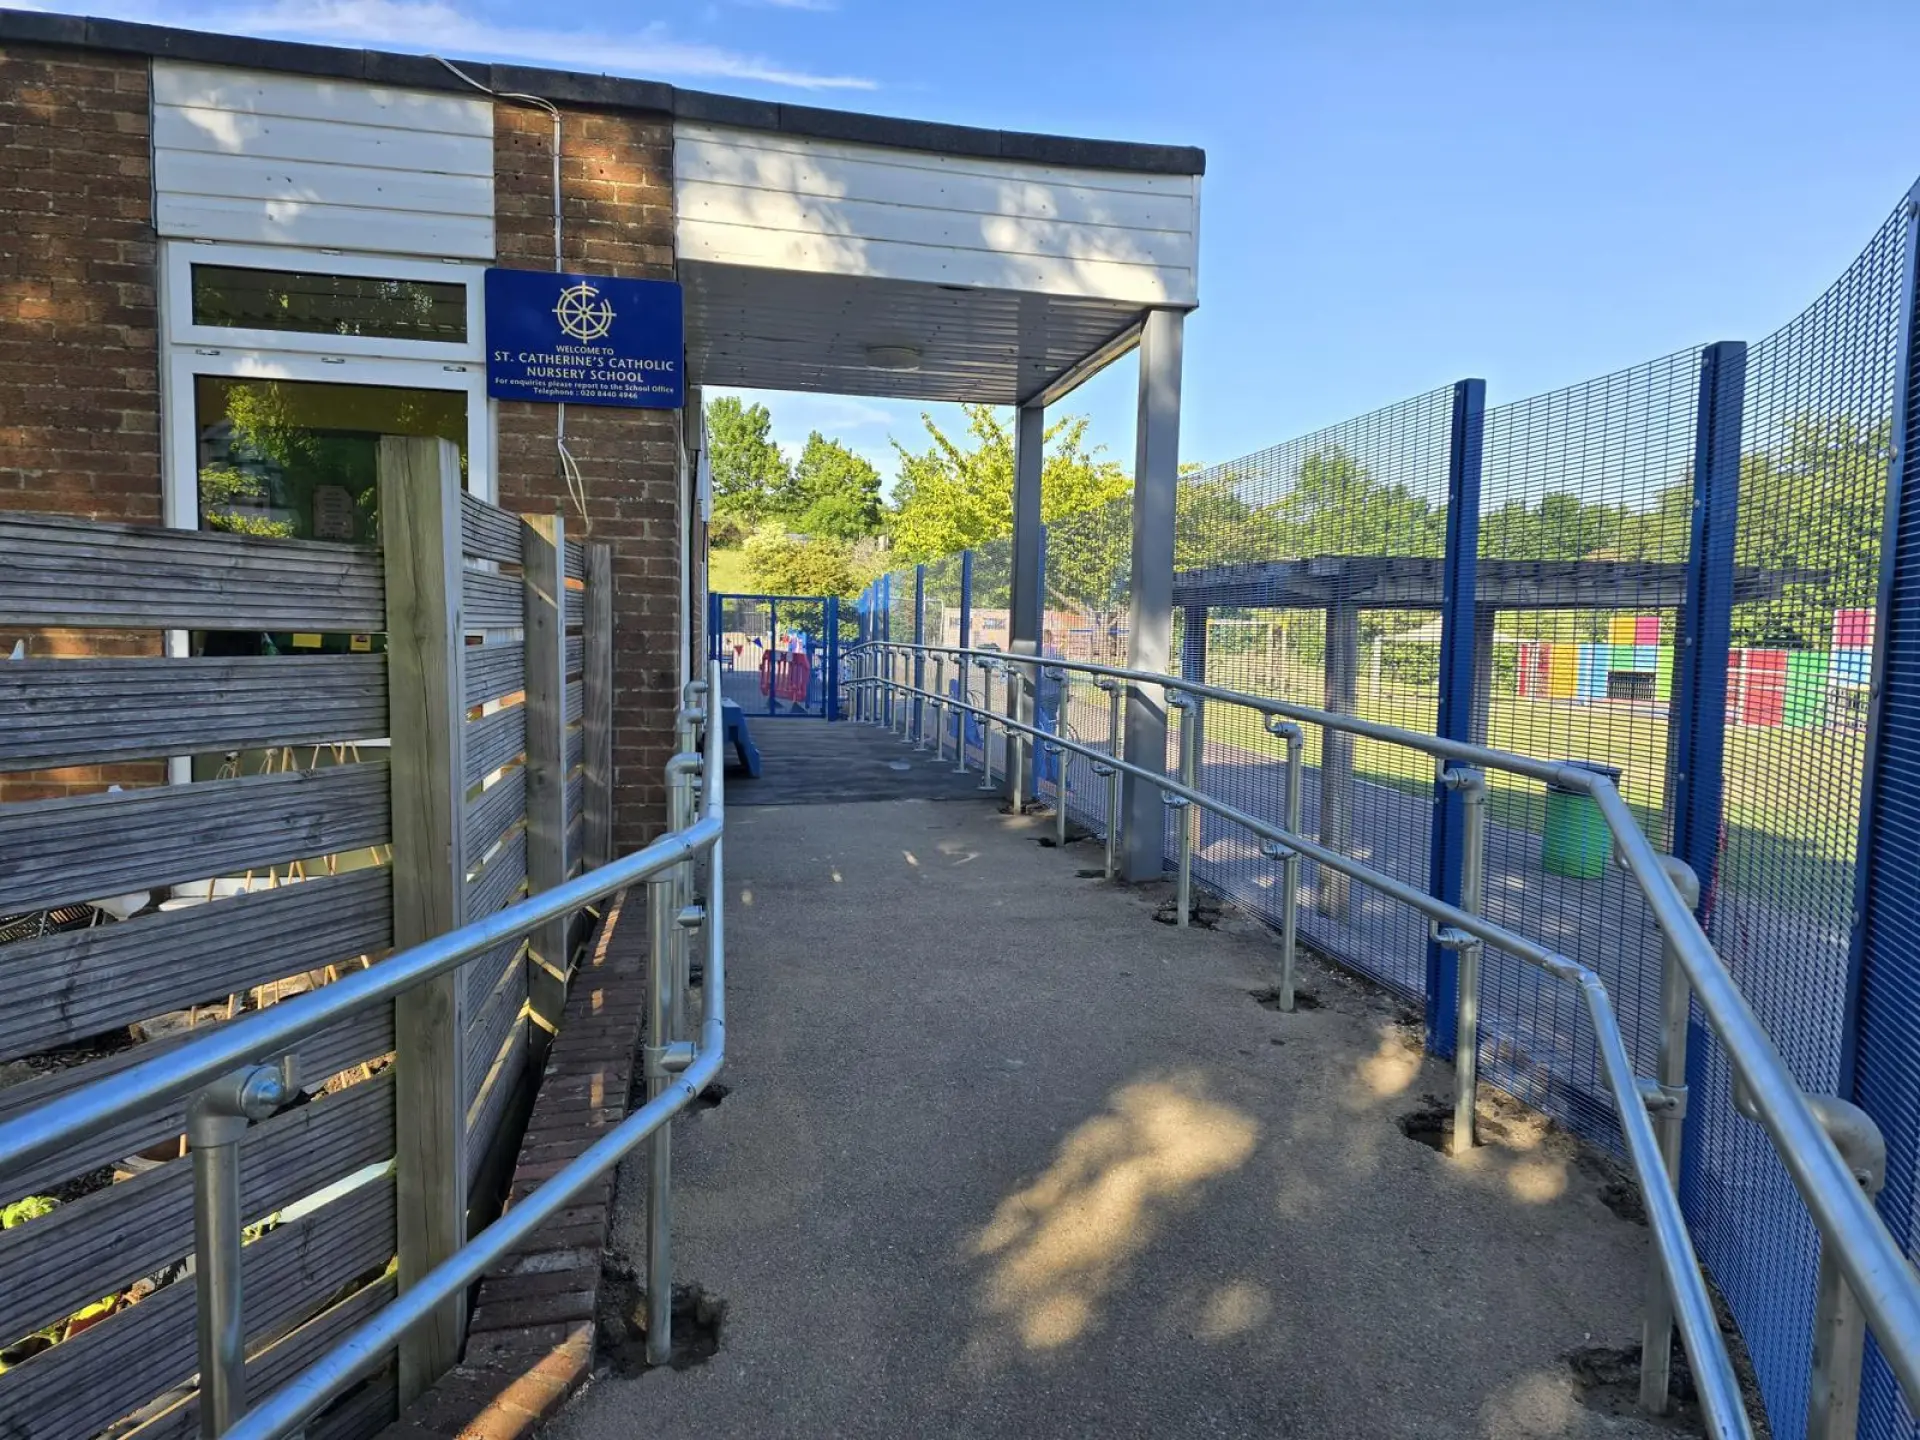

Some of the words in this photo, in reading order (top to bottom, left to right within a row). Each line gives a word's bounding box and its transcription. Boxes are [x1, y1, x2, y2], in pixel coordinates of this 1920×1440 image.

[556, 345, 600, 355] WELCOME
[602, 347, 614, 356] TO
[494, 351, 514, 362] ST.
[518, 353, 604, 367] CATHERINE'S
[608, 358, 674, 372] CATHOLIC
[527, 367, 586, 379] NURSERY
[590, 370, 644, 383] SCHOOL
[510, 379, 546, 387] enquiries
[625, 384, 650, 393] School
[652, 386, 674, 394] Office
[534, 388, 574, 396] Telephone
